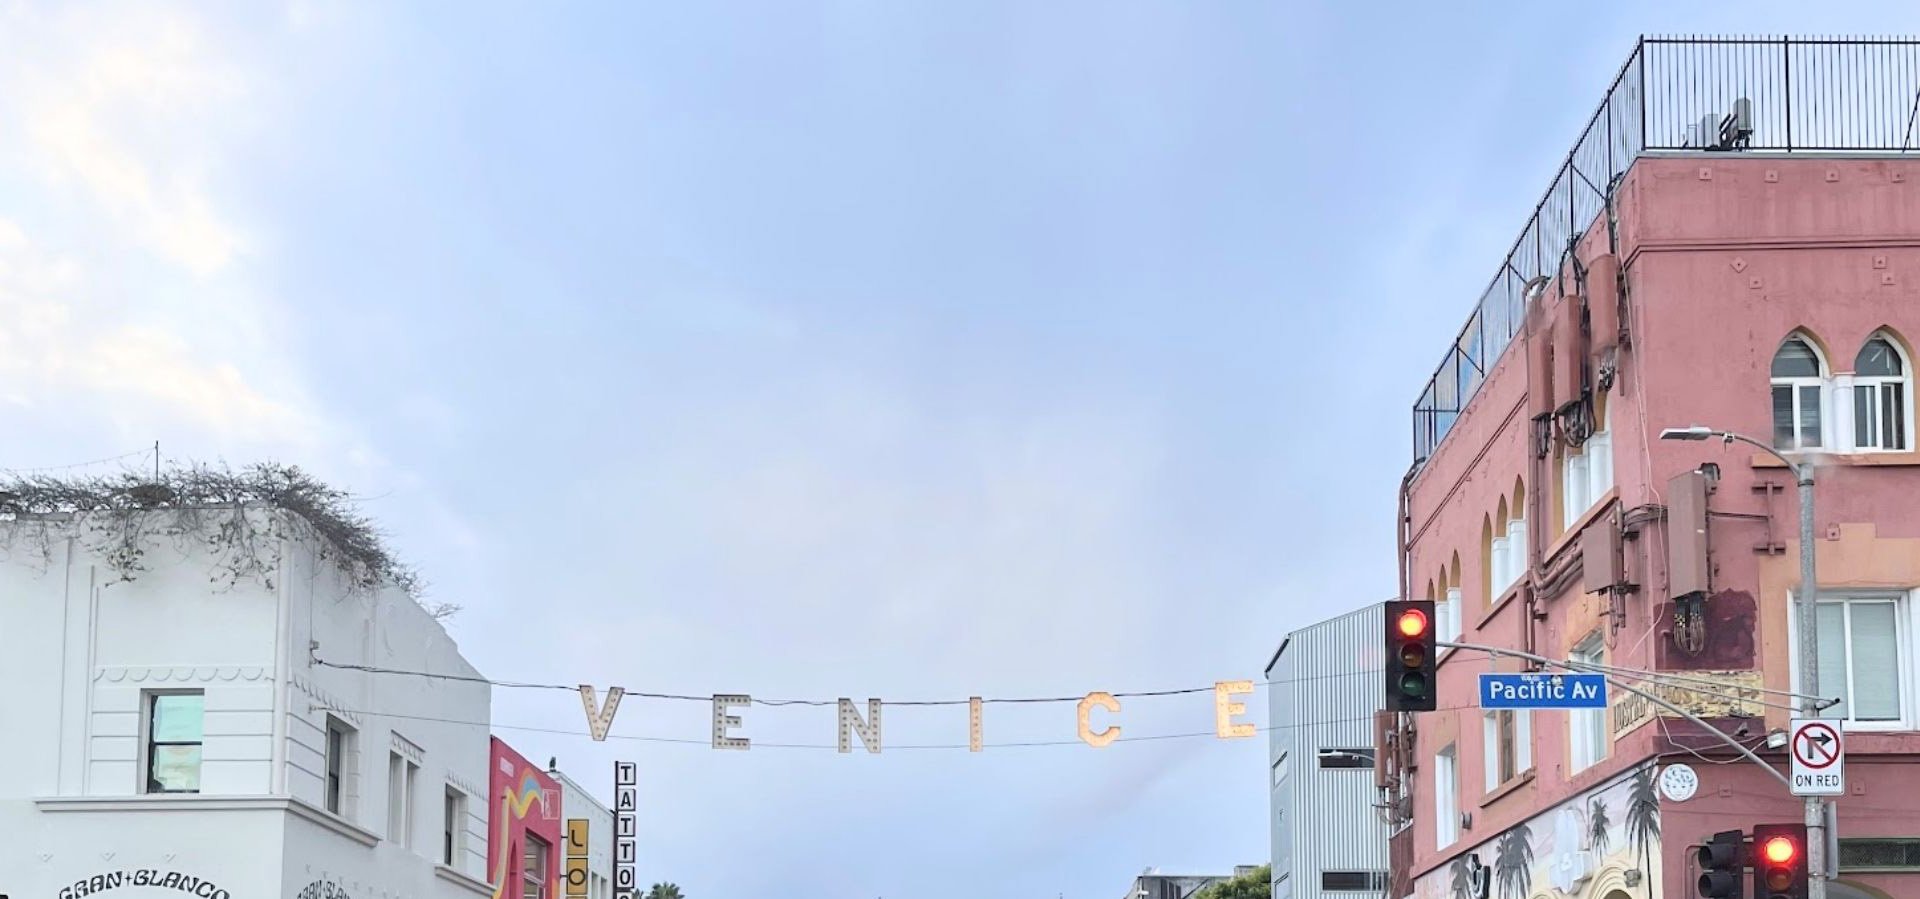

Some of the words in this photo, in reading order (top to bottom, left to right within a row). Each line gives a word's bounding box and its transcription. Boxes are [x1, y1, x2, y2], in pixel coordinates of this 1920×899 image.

[1490, 681, 1565, 699] Pacific
[1572, 681, 1598, 699] Av
[578, 680, 1257, 754] VENICE
[1795, 775, 1812, 787] ON
[1816, 775, 1840, 787] RED
[619, 765, 631, 899] TATTO
[59, 870, 123, 899] GRAN
